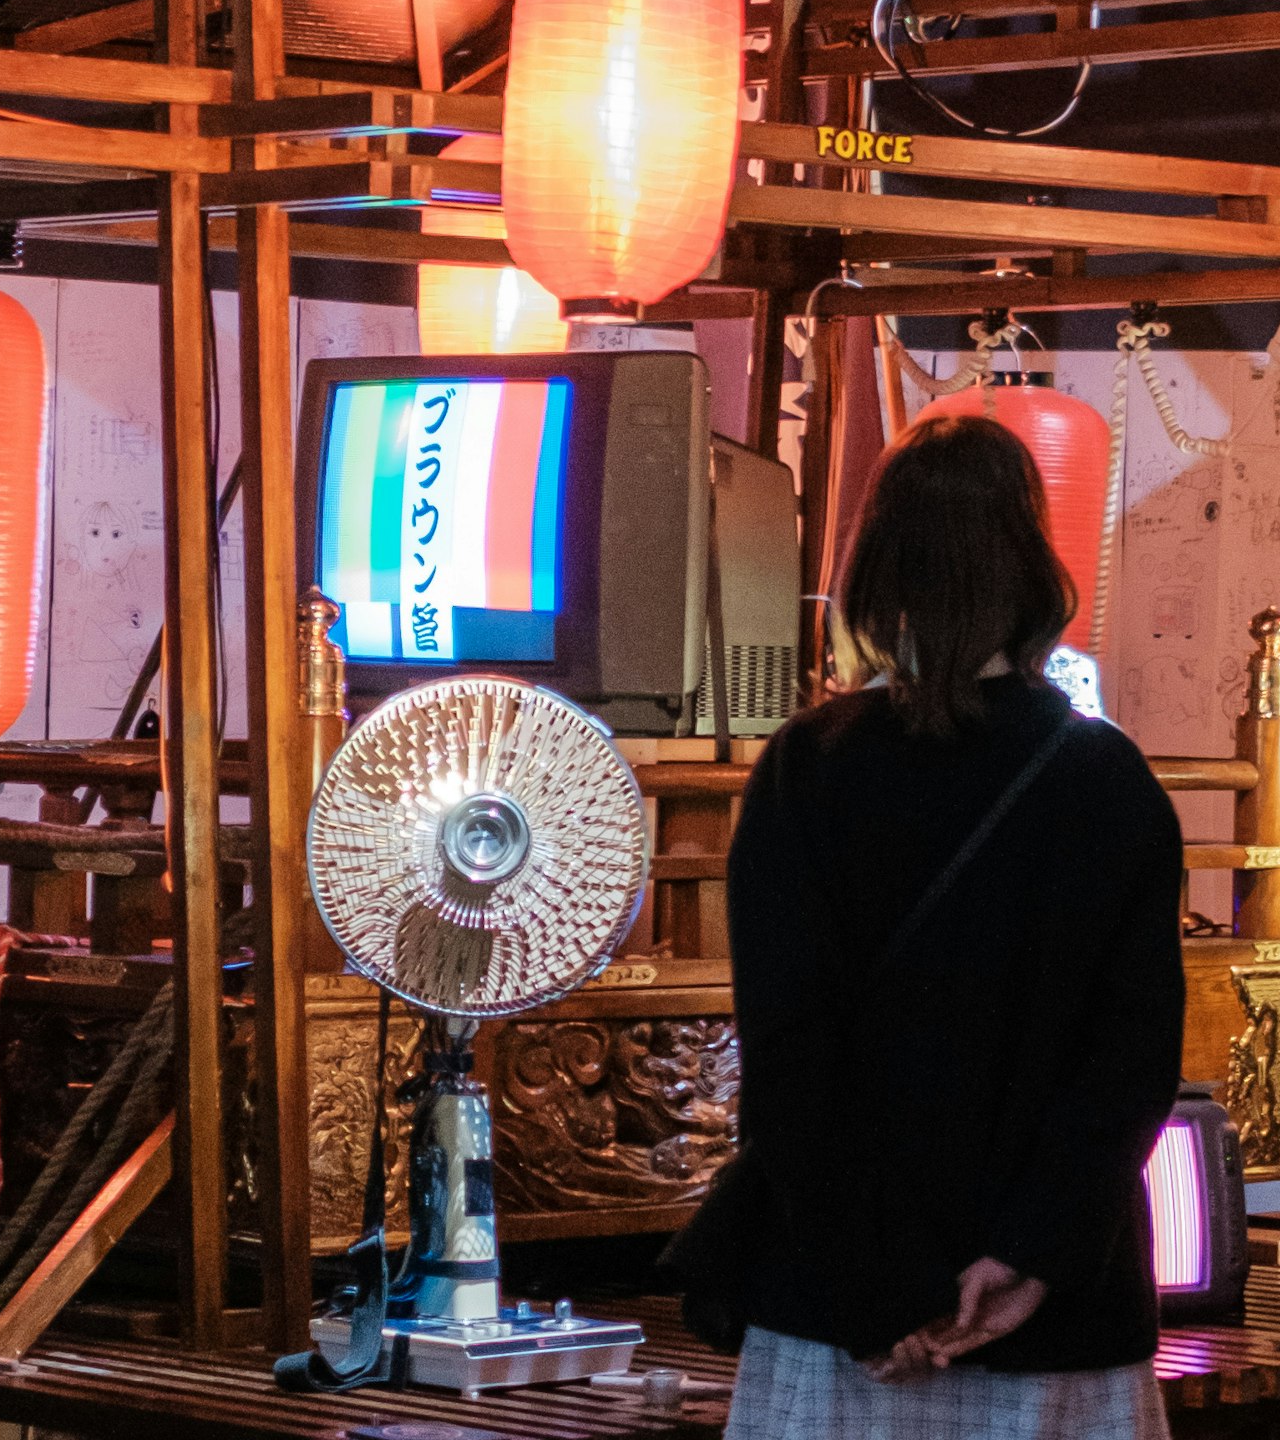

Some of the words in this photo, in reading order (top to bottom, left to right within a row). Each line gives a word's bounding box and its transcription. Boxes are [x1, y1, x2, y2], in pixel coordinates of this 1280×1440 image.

[817, 126, 912, 163] FORCE
[411, 388, 456, 652] ブラウン管
